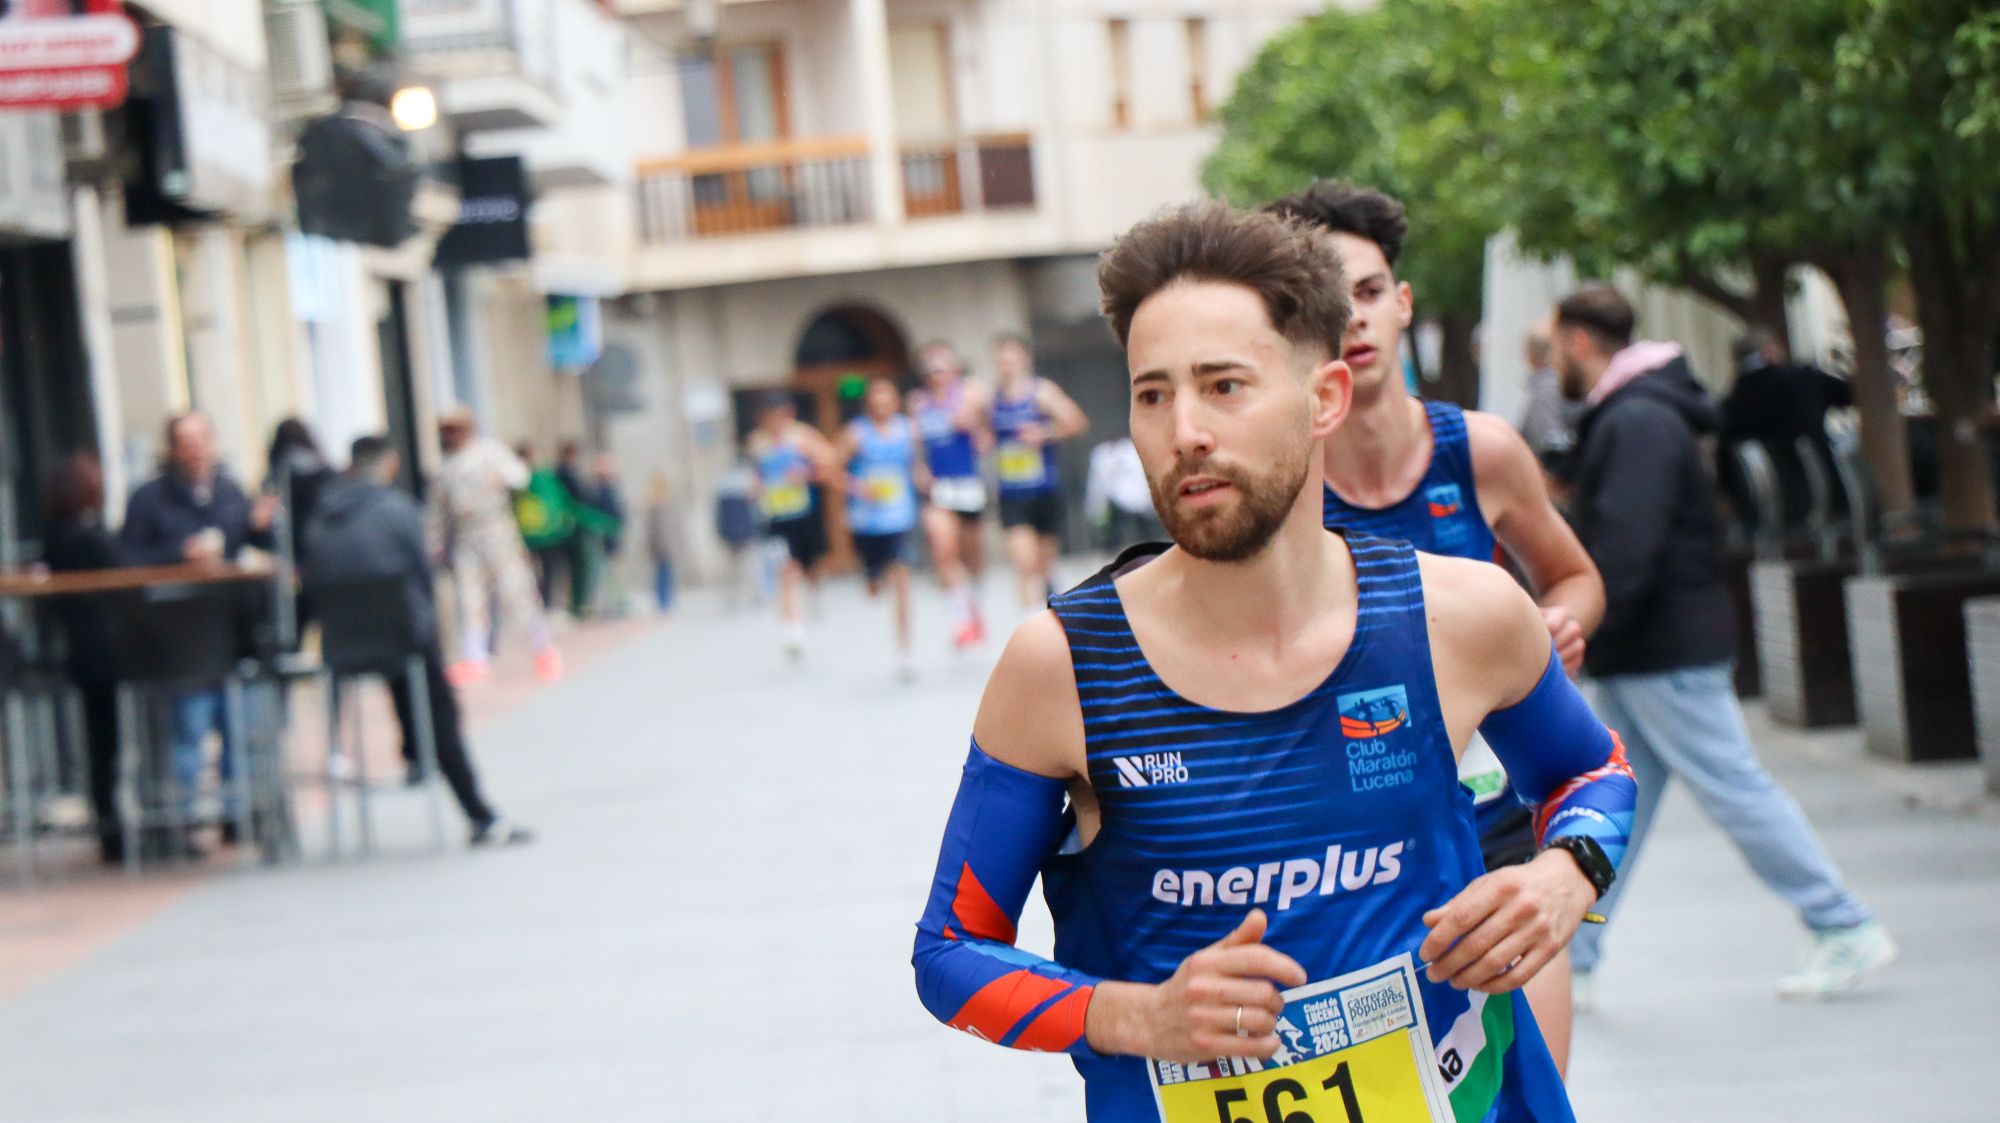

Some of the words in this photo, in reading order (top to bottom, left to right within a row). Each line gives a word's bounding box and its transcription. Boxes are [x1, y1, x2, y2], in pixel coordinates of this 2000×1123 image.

[1346, 738, 1386, 759] Club
[1144, 751, 1182, 771] RUN
[1348, 749, 1417, 776] Maratón
[1152, 766, 1189, 786] PRO
[1351, 769, 1414, 792] Lucena
[1152, 840, 1404, 911] enerplus
[1348, 986, 1393, 1009] carreras
[1349, 990, 1405, 1021] populares
[1306, 1006, 1341, 1025] LUCENA
[1313, 1029, 1348, 1054] 2026
